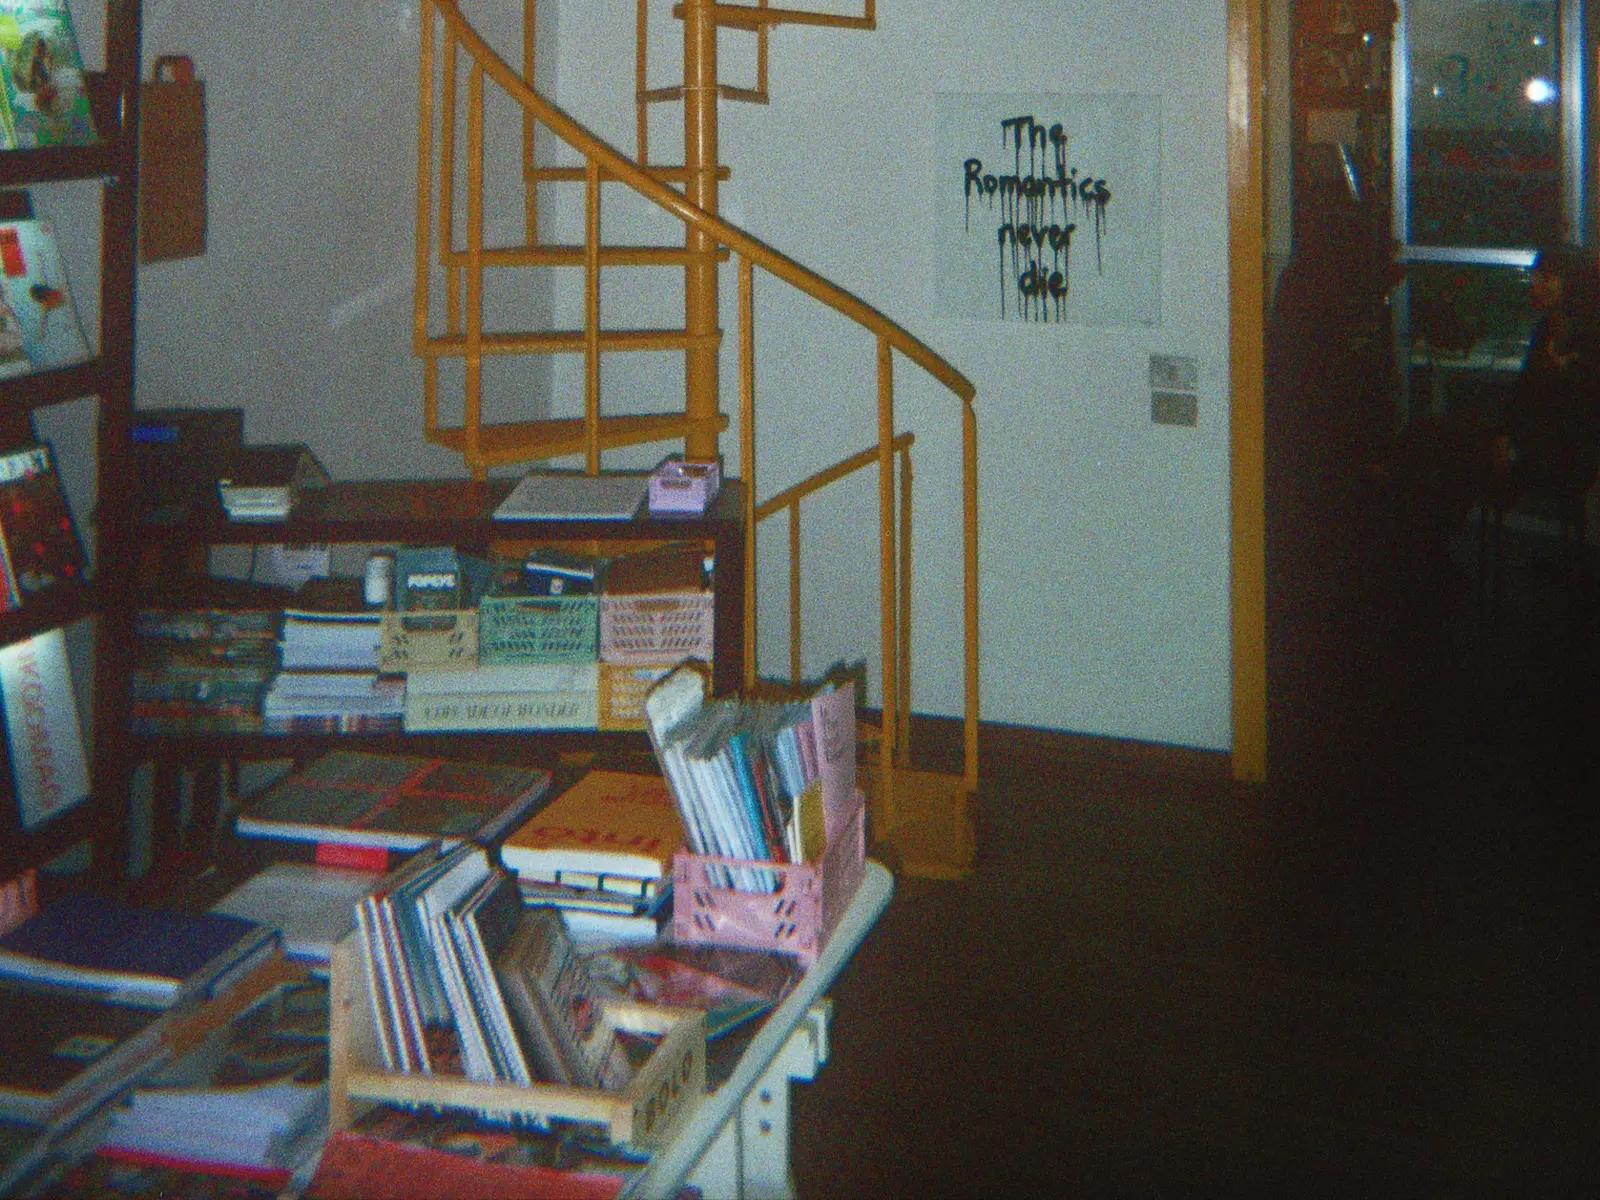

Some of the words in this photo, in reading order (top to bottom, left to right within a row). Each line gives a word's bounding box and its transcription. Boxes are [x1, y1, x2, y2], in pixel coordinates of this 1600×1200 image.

[1001, 116, 1068, 152] The
[963, 158, 1111, 206] Romantics
[997, 223, 1076, 253] never
[1018, 260, 1069, 301] die
